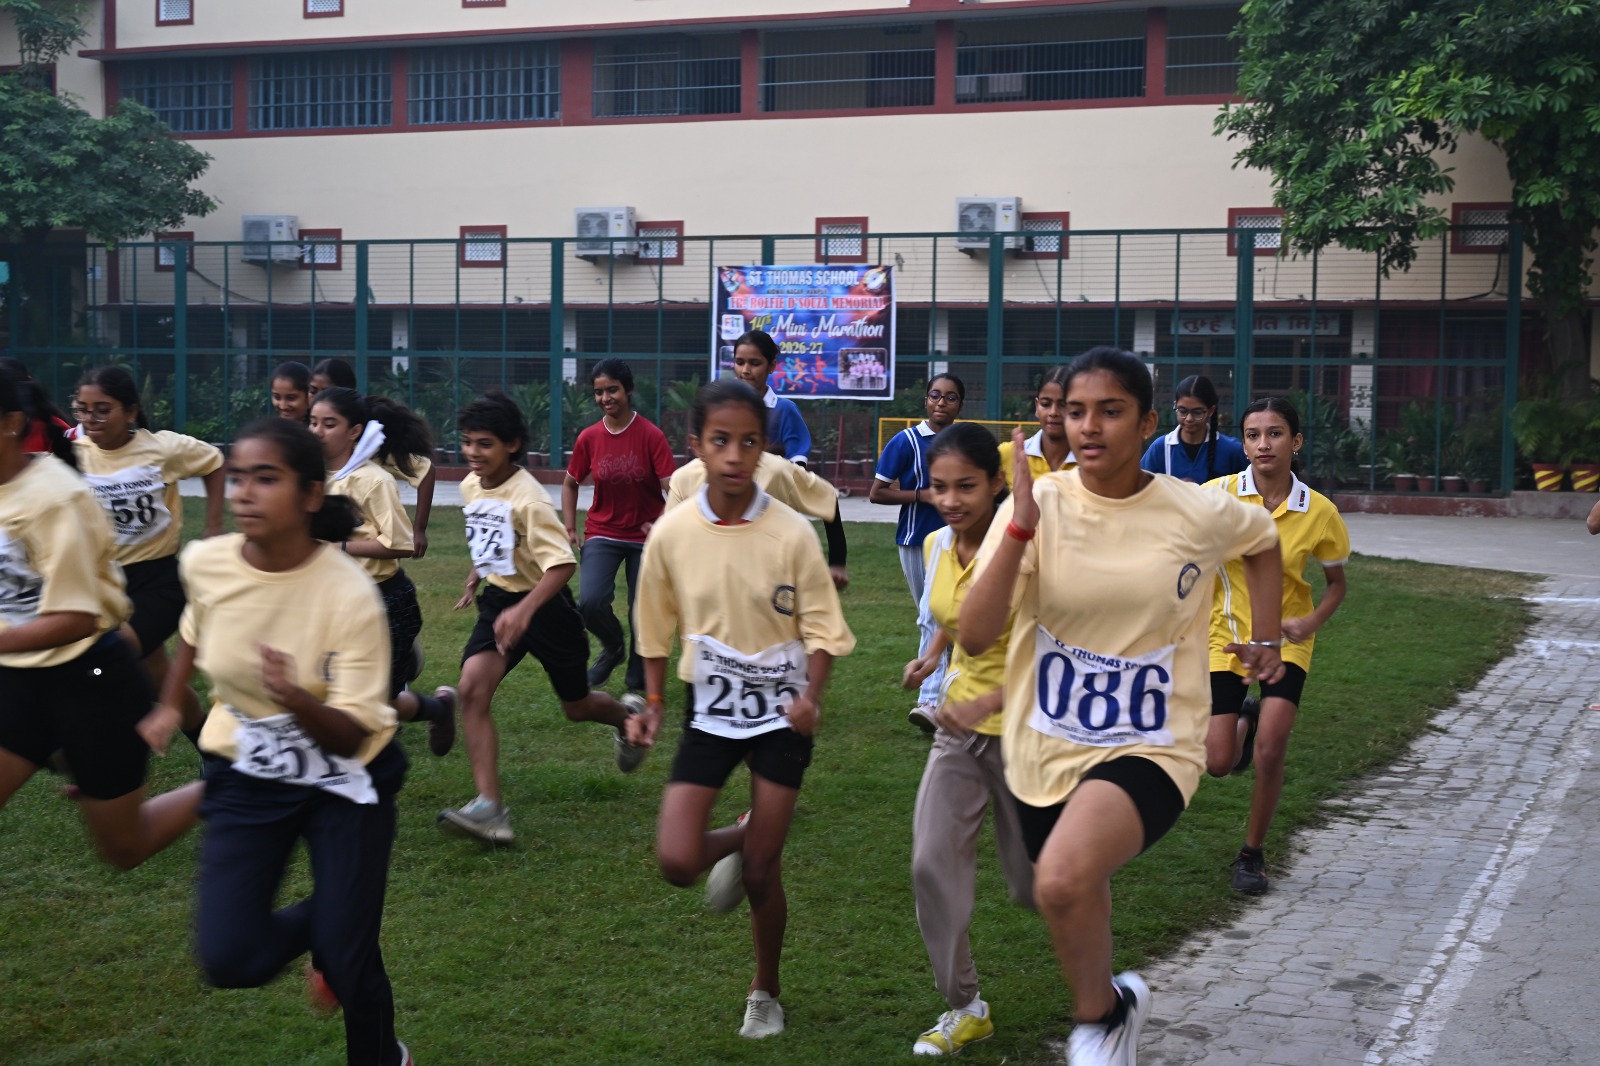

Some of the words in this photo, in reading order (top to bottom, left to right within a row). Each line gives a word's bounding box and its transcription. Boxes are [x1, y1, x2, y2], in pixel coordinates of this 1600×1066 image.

[749, 270, 764, 285] ST.
[767, 270, 813, 285] THOMAS
[816, 270, 860, 285] SCHOOL
[750, 297, 785, 309] ROLFIE
[831, 297, 884, 309] MEMORIAL
[770, 313, 807, 338] Mini
[811, 312, 885, 338] Marathon
[779, 342, 824, 355] 2026-27
[1071, 647, 1121, 669] THOMAS
[707, 674, 800, 719] 255
[1038, 651, 1170, 732] 086
